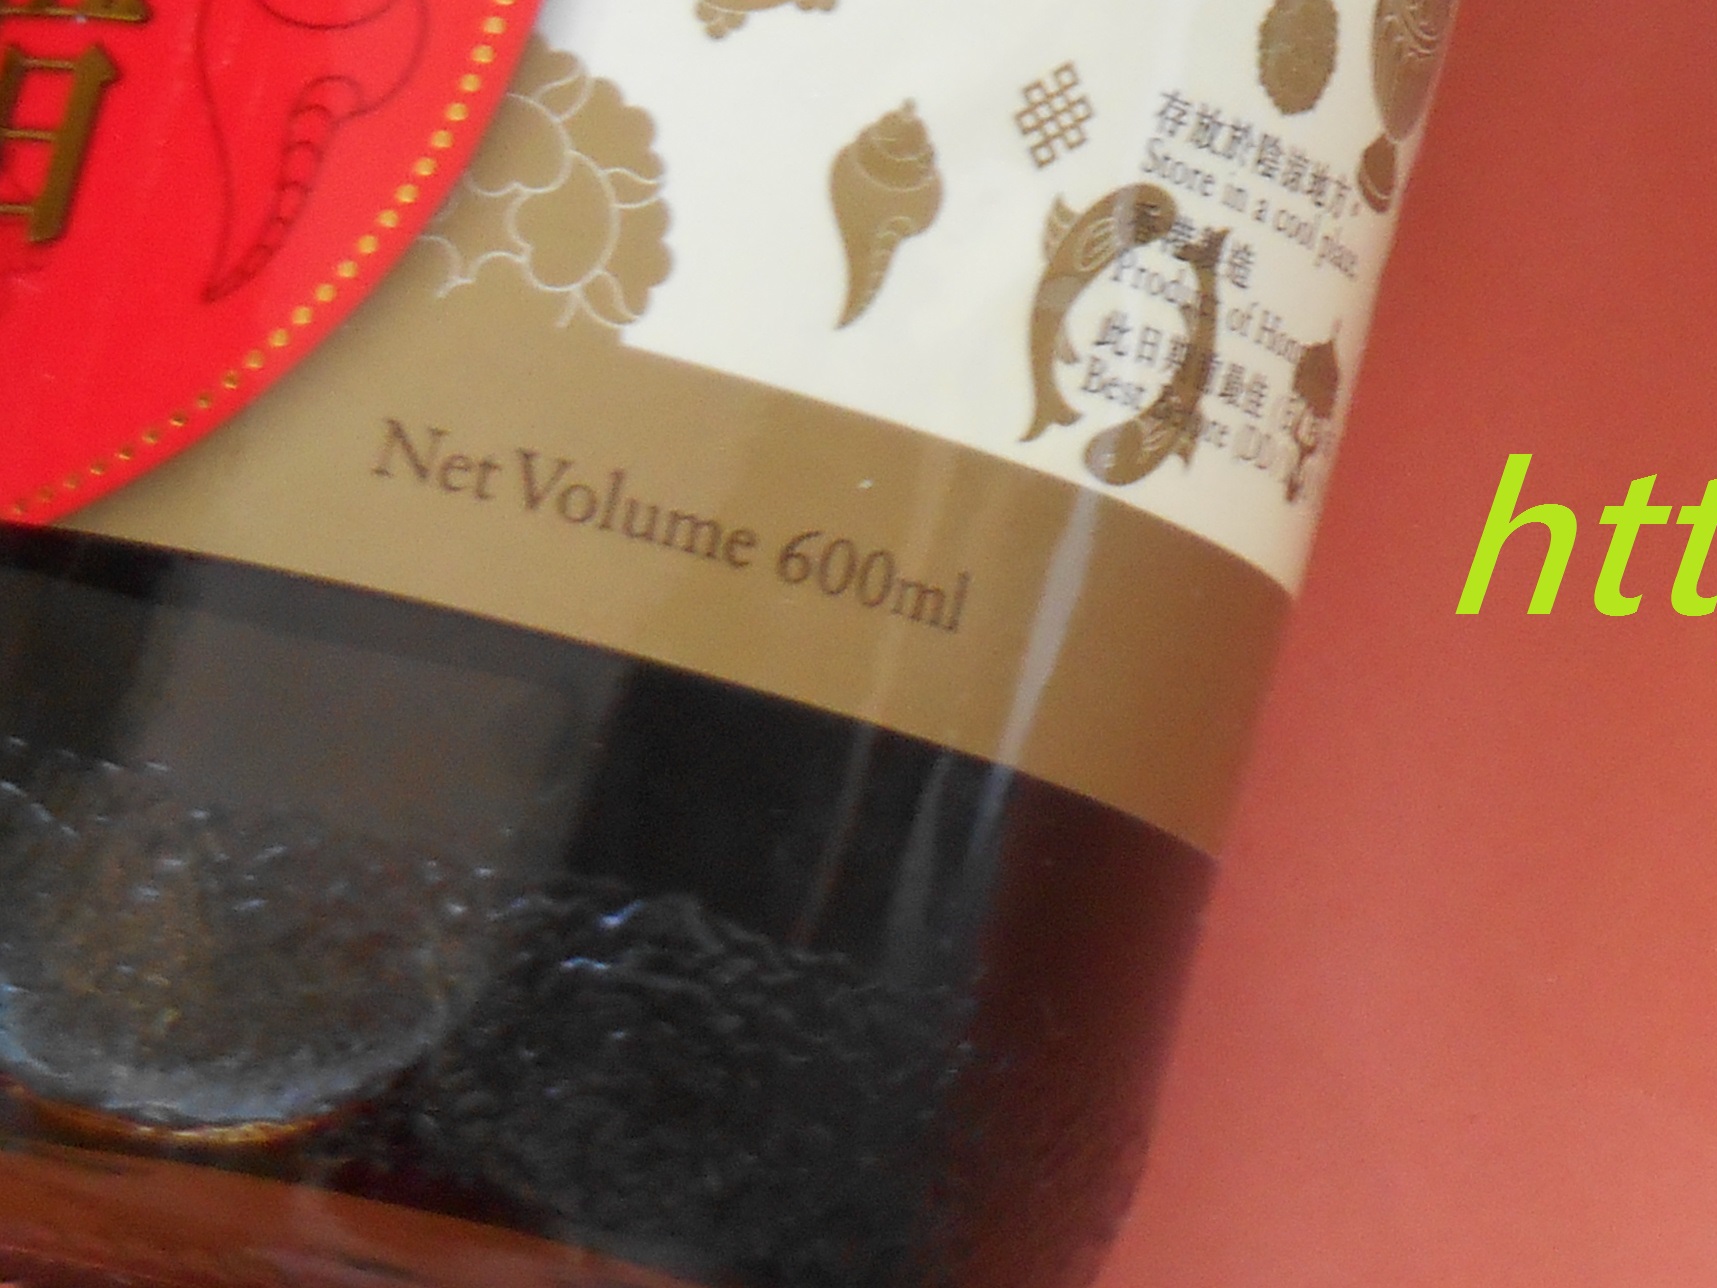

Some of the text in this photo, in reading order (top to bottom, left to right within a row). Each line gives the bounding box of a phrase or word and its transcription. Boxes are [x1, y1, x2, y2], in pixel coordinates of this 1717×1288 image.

[1140, 137, 1217, 198] Store
[371, 417, 973, 634] Net Volume 600ml
